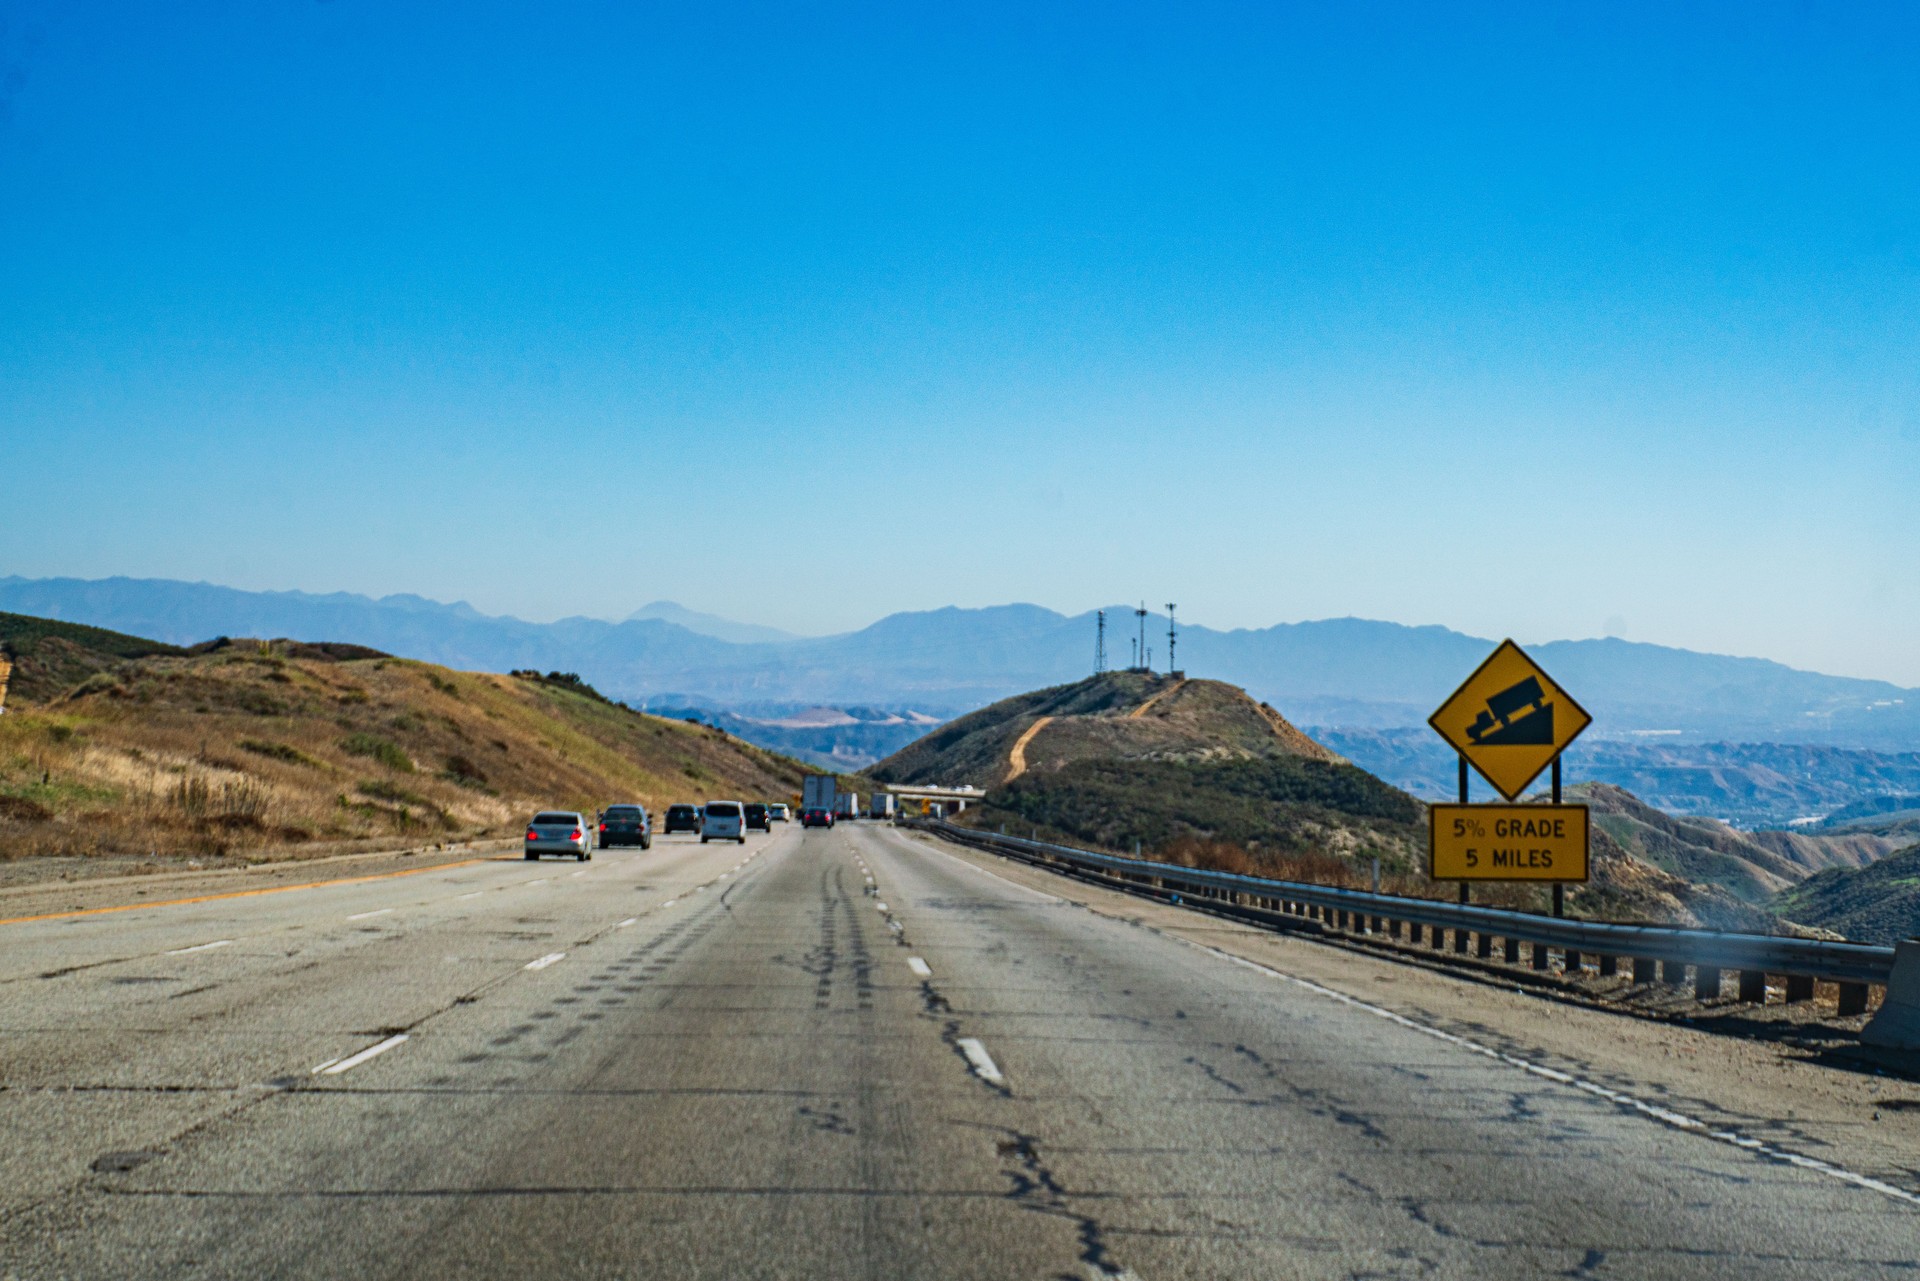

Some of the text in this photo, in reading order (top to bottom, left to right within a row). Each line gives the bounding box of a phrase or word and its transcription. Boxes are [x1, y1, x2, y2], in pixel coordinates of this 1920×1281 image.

[1454, 819, 1565, 837] 5% GRADE
[1466, 849, 1553, 867] 5 MILES
